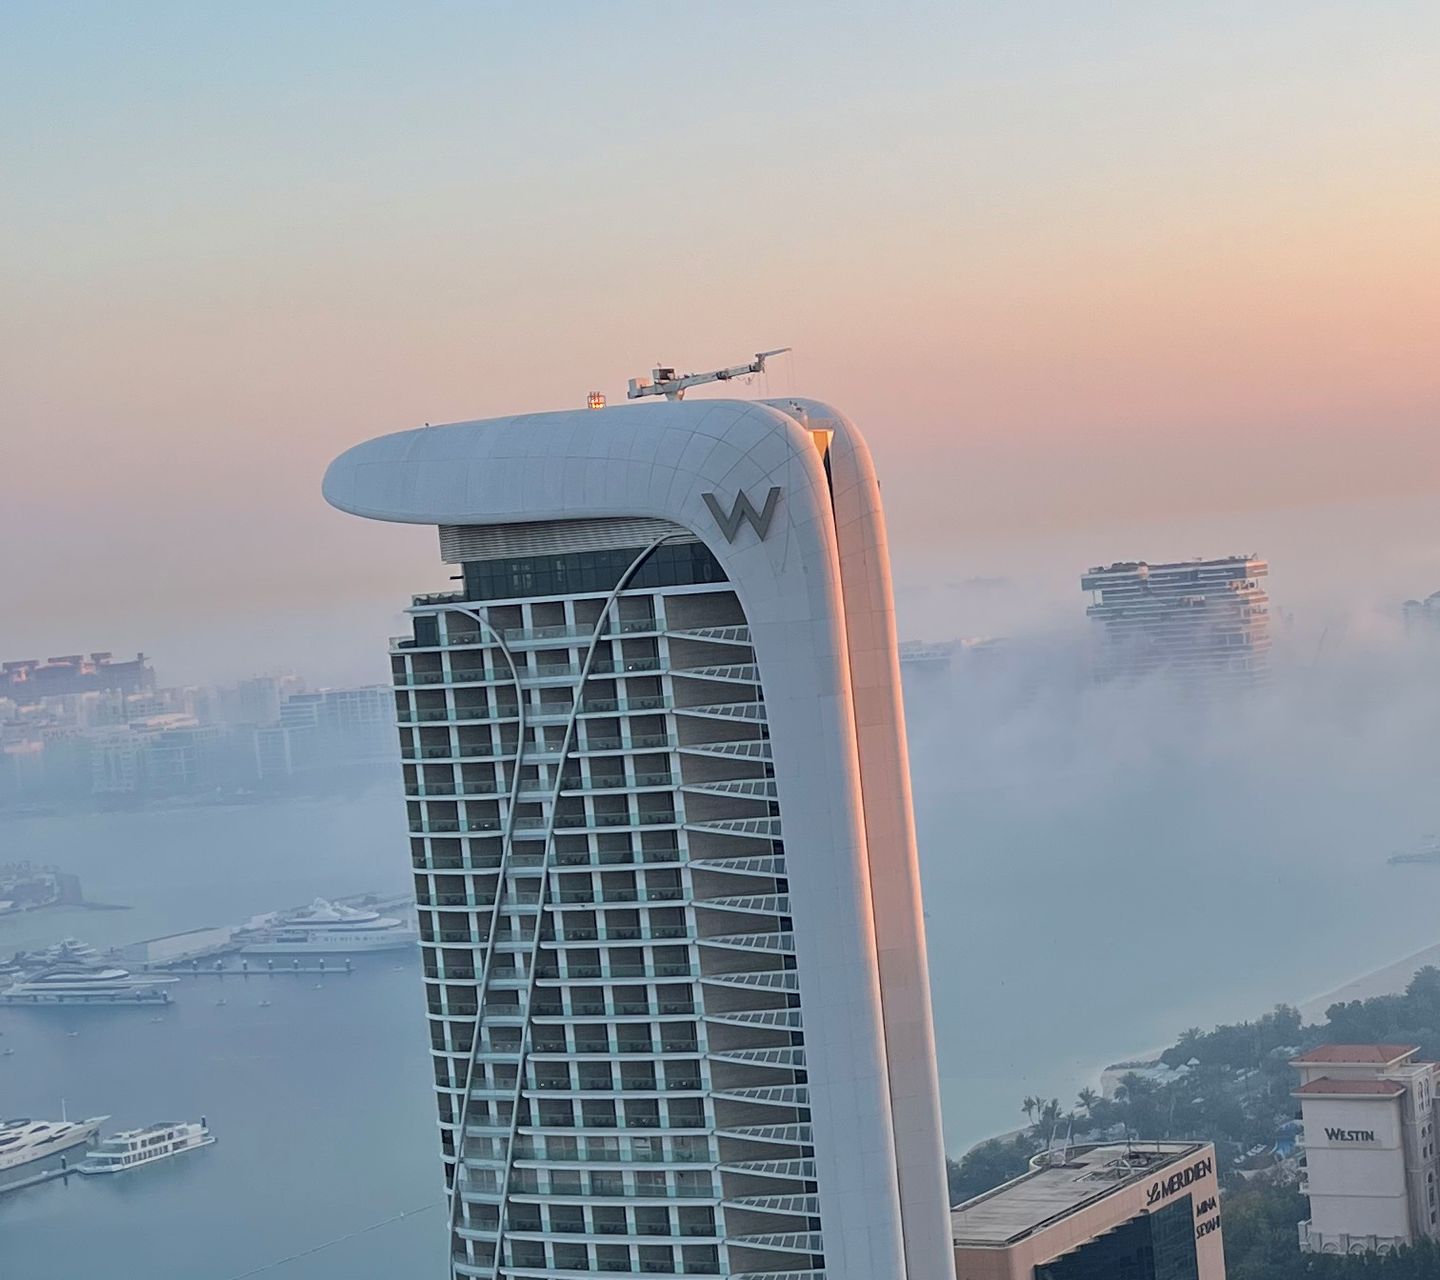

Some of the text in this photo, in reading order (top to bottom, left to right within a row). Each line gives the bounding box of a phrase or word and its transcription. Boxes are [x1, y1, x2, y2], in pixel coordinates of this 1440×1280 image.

[701, 486, 781, 544] W
[1324, 1127, 1375, 1142] WESTIN
[1146, 1182, 1161, 1206] Le
